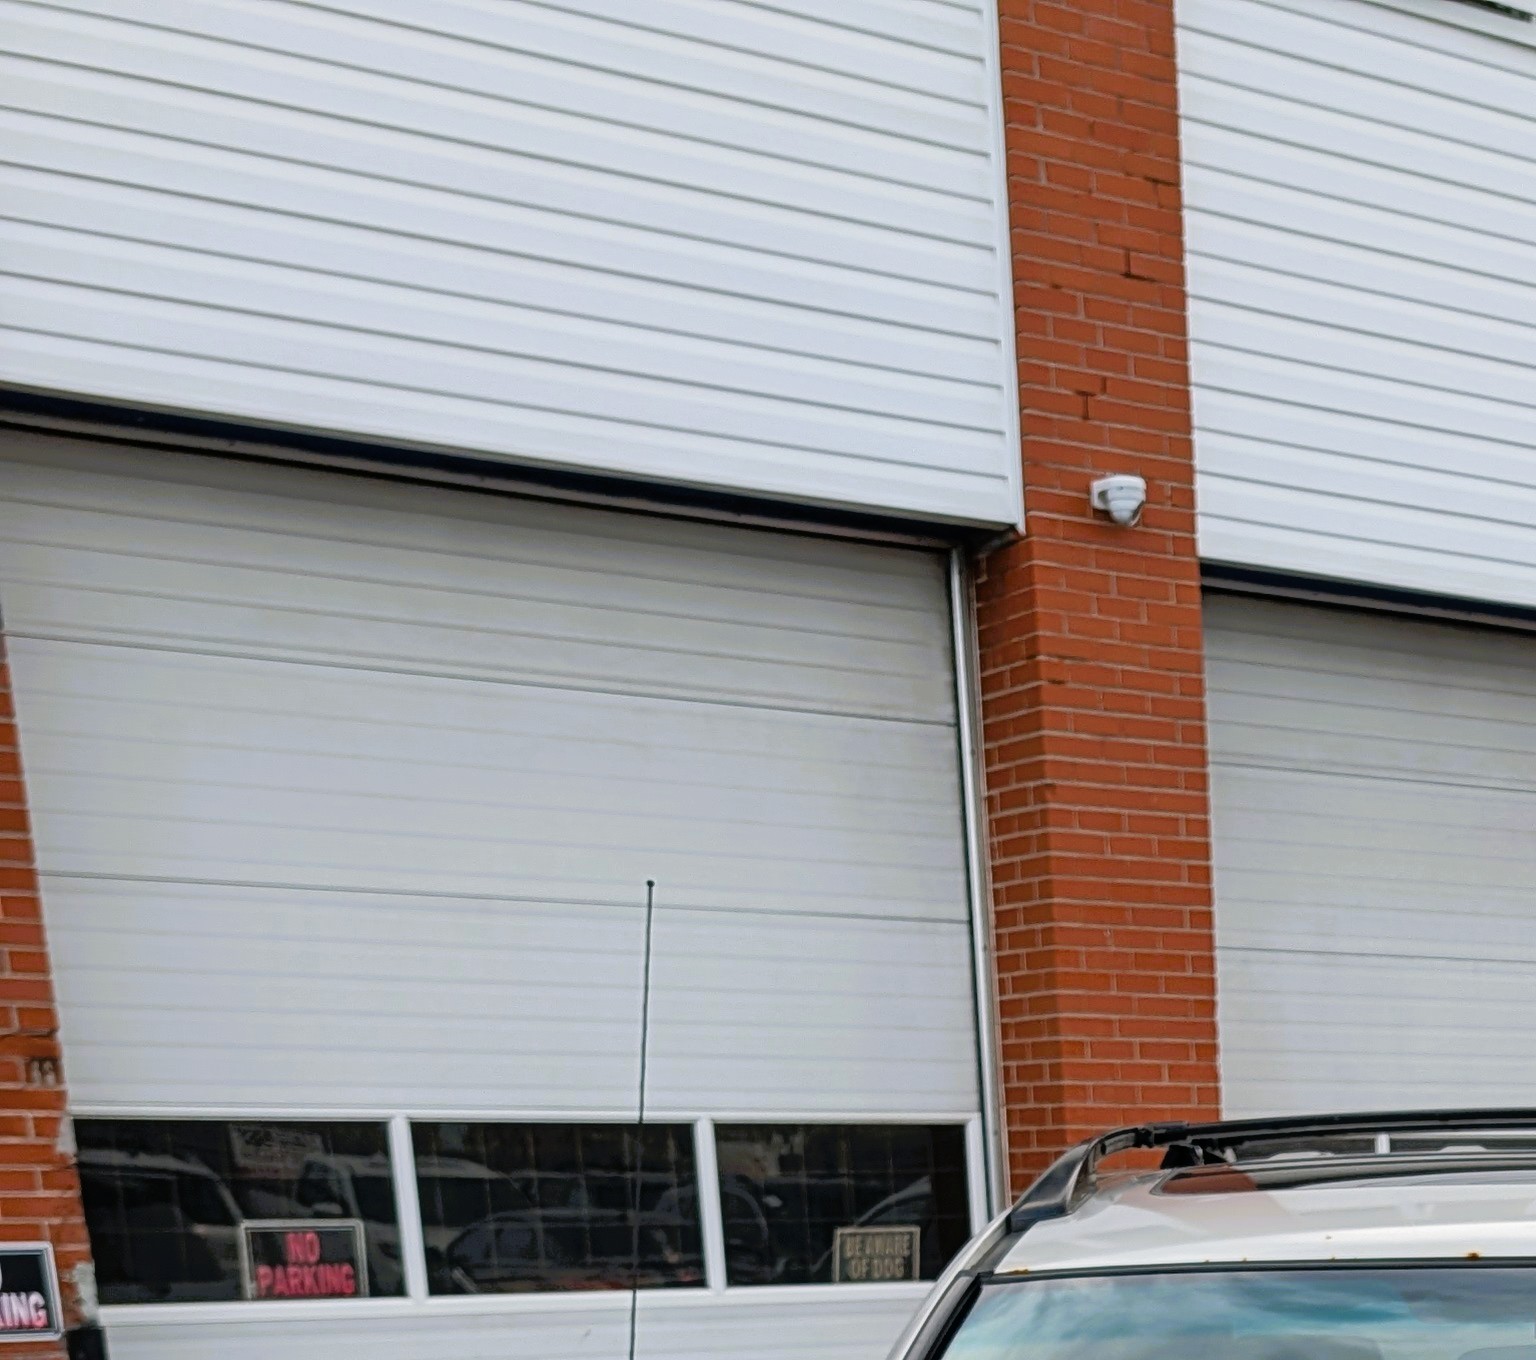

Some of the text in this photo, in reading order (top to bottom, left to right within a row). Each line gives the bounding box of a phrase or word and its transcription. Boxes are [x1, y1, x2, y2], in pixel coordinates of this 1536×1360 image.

[286, 1231, 320, 1264] NO
[255, 1263, 356, 1298] PARKING
[870, 1257, 905, 1279] DOG
